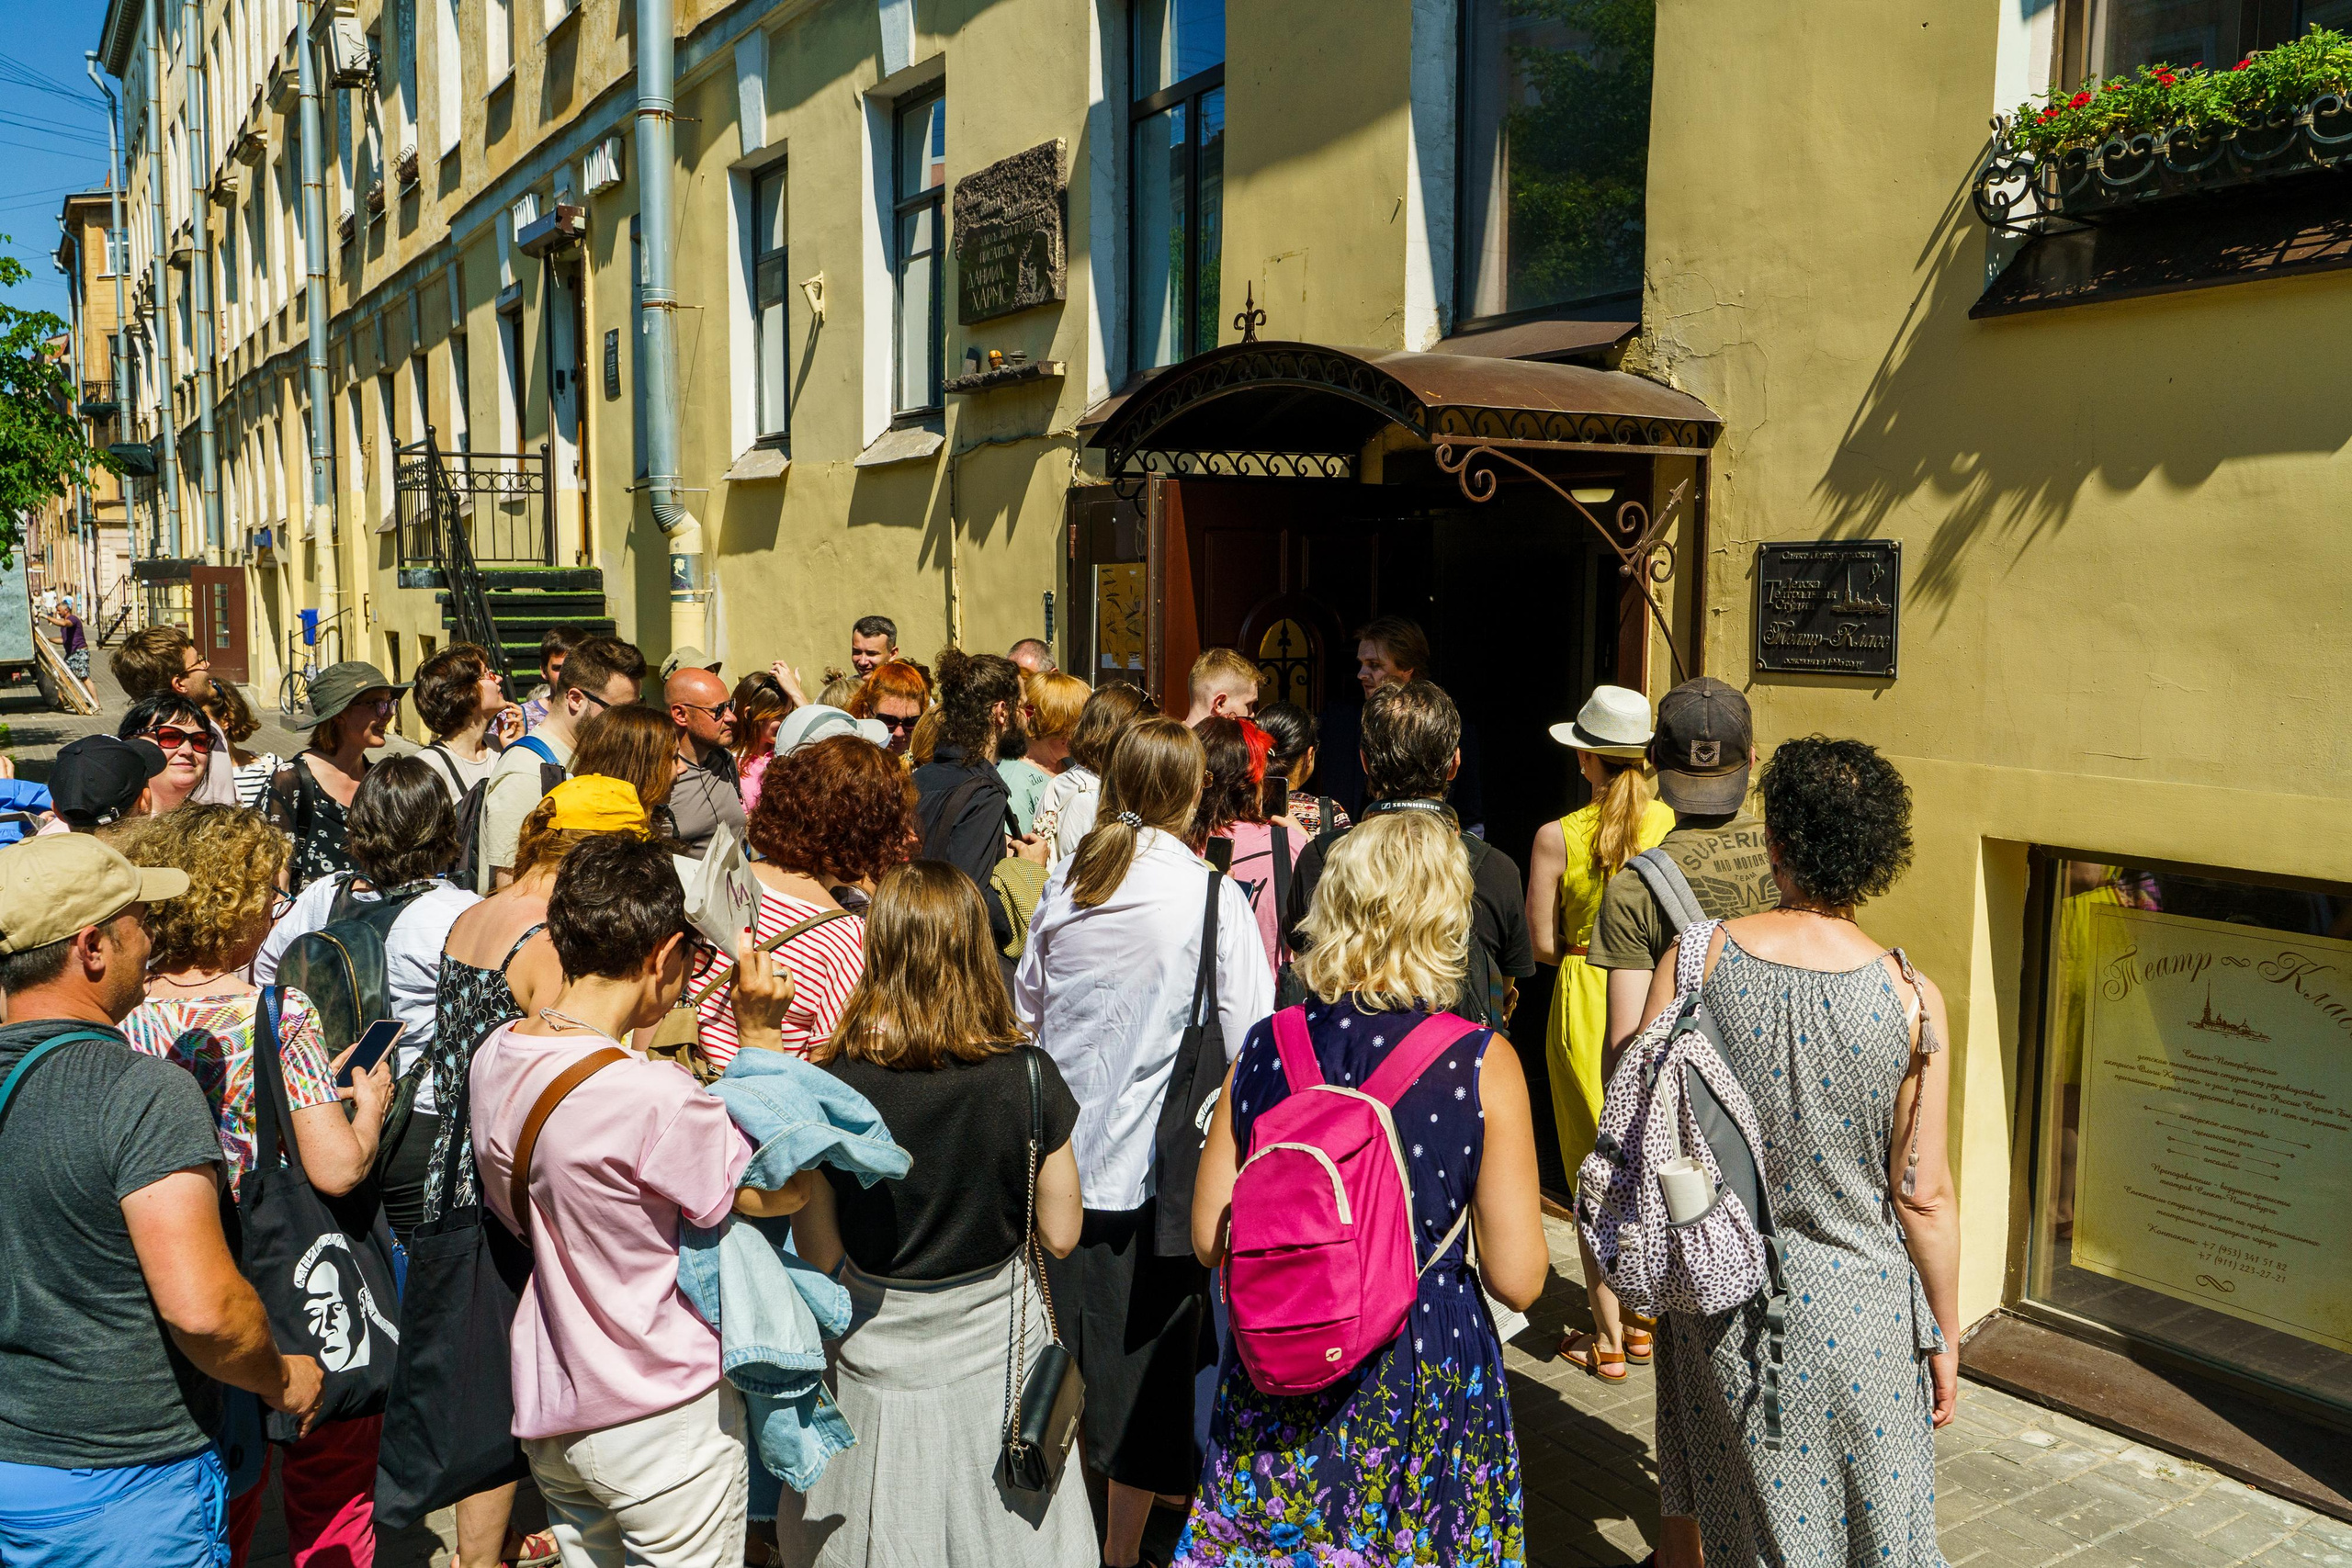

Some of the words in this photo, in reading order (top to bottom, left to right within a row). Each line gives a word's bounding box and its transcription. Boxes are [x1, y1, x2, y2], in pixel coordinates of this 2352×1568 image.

[979, 243, 1014, 264] ПИСАТЕЛЬ
[967, 261, 1005, 290] ДАНИИЛ
[972, 282, 1010, 311] ХАРМС
[1392, 802, 1441, 812] SENNHEISER
[1713, 859, 1732, 873] MAD
[1734, 871, 1758, 882] TEAM
[2103, 944, 2212, 1002] Театр
[2257, 951, 2352, 1041] Клас
[2182, 1048, 2278, 1076] Санкт-Петербургская
[2103, 1058, 2136, 1071] актрисы
[2137, 1064, 2161, 1076] Ольги
[2232, 1088, 2268, 1100] артиста
[2269, 1093, 2301, 1108] России
[2302, 1100, 2335, 1115] Сергея
[2136, 1055, 2168, 1065] детская
[2168, 1061, 2219, 1076] театральная
[2219, 1072, 2250, 1083] студия
[2250, 1078, 2265, 1088] под
[2266, 1083, 2326, 1100] руководством
[2114, 1073, 2159, 1089] приглашает
[2158, 1084, 2182, 1094] детей
[2189, 1090, 2236, 1106] подростков
[2250, 1102, 2256, 1111] 6
[2257, 1106, 2268, 1114] до
[2269, 1107, 2279, 1115] 18
[2281, 1111, 2298, 1121] лет
[2179, 1113, 2220, 1127] актерское
[2220, 1123, 2270, 1139] мастерство
[2191, 1129, 2238, 1145] сценическая
[2238, 1141, 2255, 1149] речь
[2203, 1145, 2241, 1158] пластика
[2203, 1157, 2240, 1170] ансамбль
[2151, 1162, 2212, 1186] Преподаватели
[2220, 1182, 2253, 1197] ведущие
[2253, 1193, 2291, 1208] артисты
[2159, 1179, 2193, 1191] театров
[2123, 1185, 2167, 1203] Спектакли
[2167, 1201, 2196, 1212] студии
[2196, 1208, 2233, 1223] проходят
[2235, 1218, 2246, 1226] на
[2246, 1223, 2321, 1247] профессиональных
[2156, 1209, 2207, 1228] театральных
[2208, 1224, 2251, 1240] площадках
[2147, 1223, 2199, 1246] Контакты:
[2202, 1240, 2216, 1250] +7
[2218, 1244, 2242, 1260] (953)
[2244, 1252, 2260, 1264] 341
[2263, 1258, 2274, 1268] 51
[2276, 1261, 2289, 1272] 82
[2198, 1251, 2212, 1261] +7
[2214, 1255, 2237, 1271] (911)
[2239, 1263, 2287, 1283] 223-27-21
